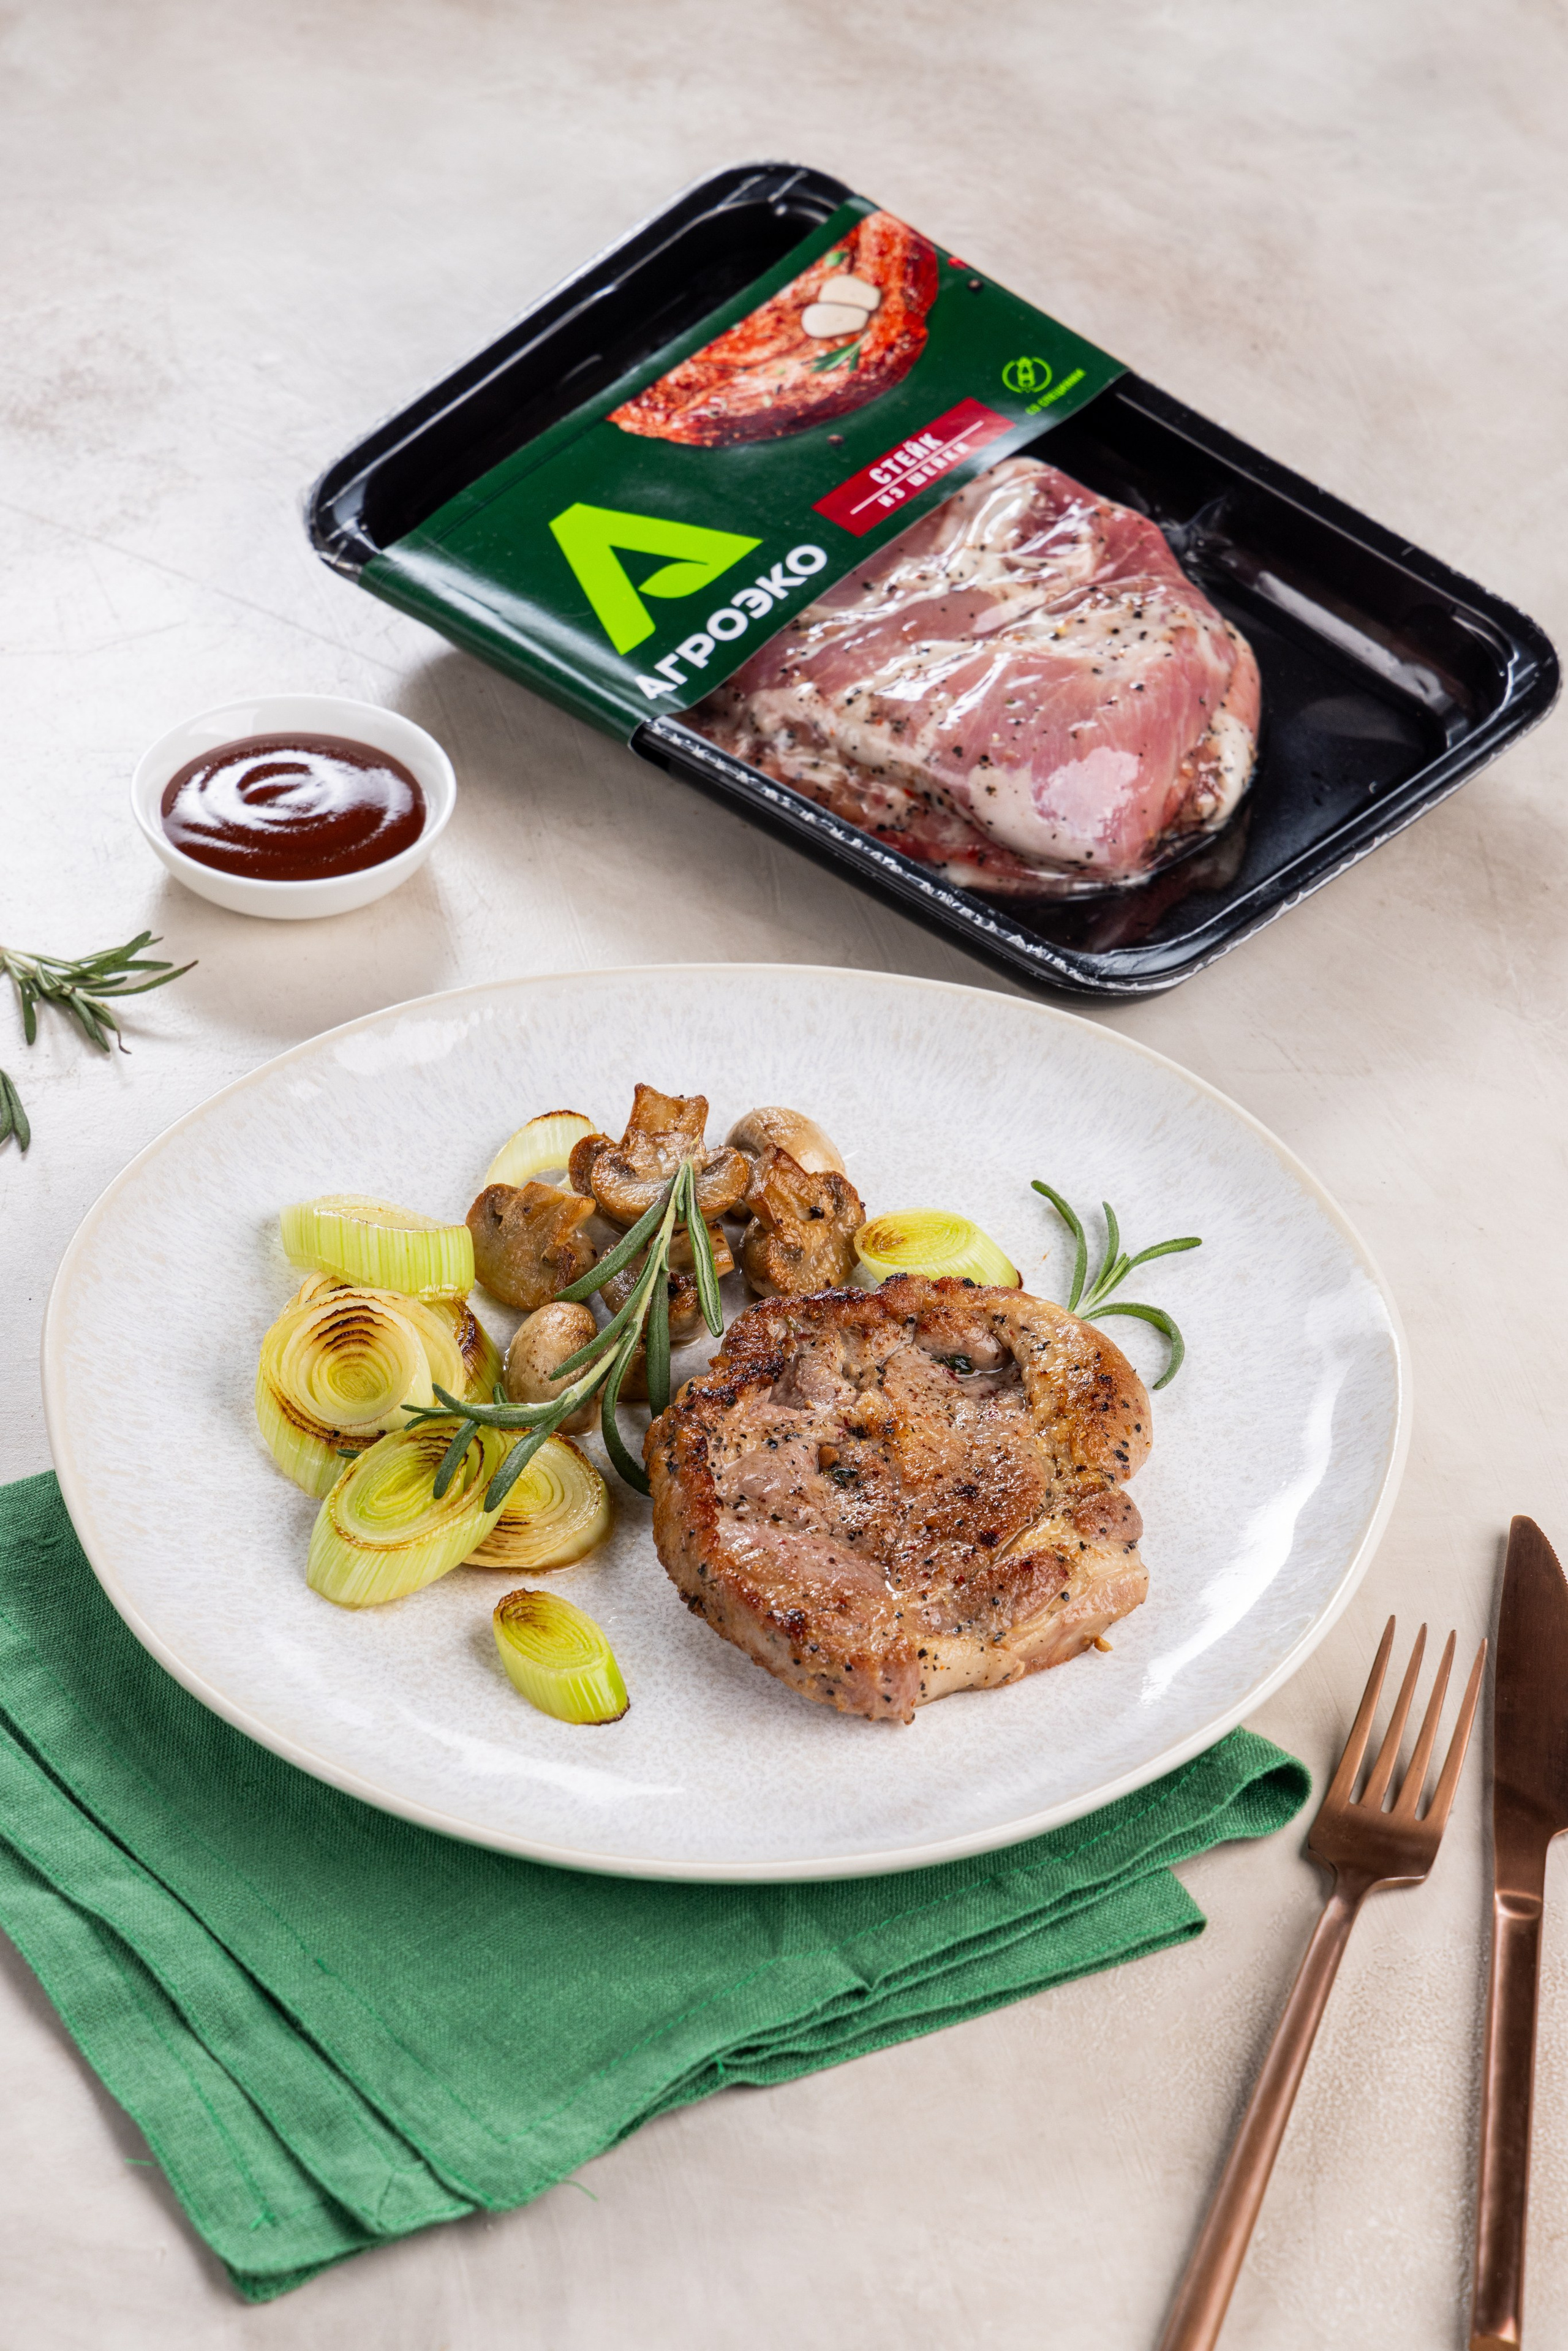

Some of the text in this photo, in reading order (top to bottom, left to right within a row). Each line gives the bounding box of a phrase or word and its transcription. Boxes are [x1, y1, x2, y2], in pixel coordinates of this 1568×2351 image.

[869, 432, 944, 485] СТЕЙК
[877, 441, 971, 508] ИЗ ШЕЙКИ
[635, 545, 827, 700] АГРОЭКО
